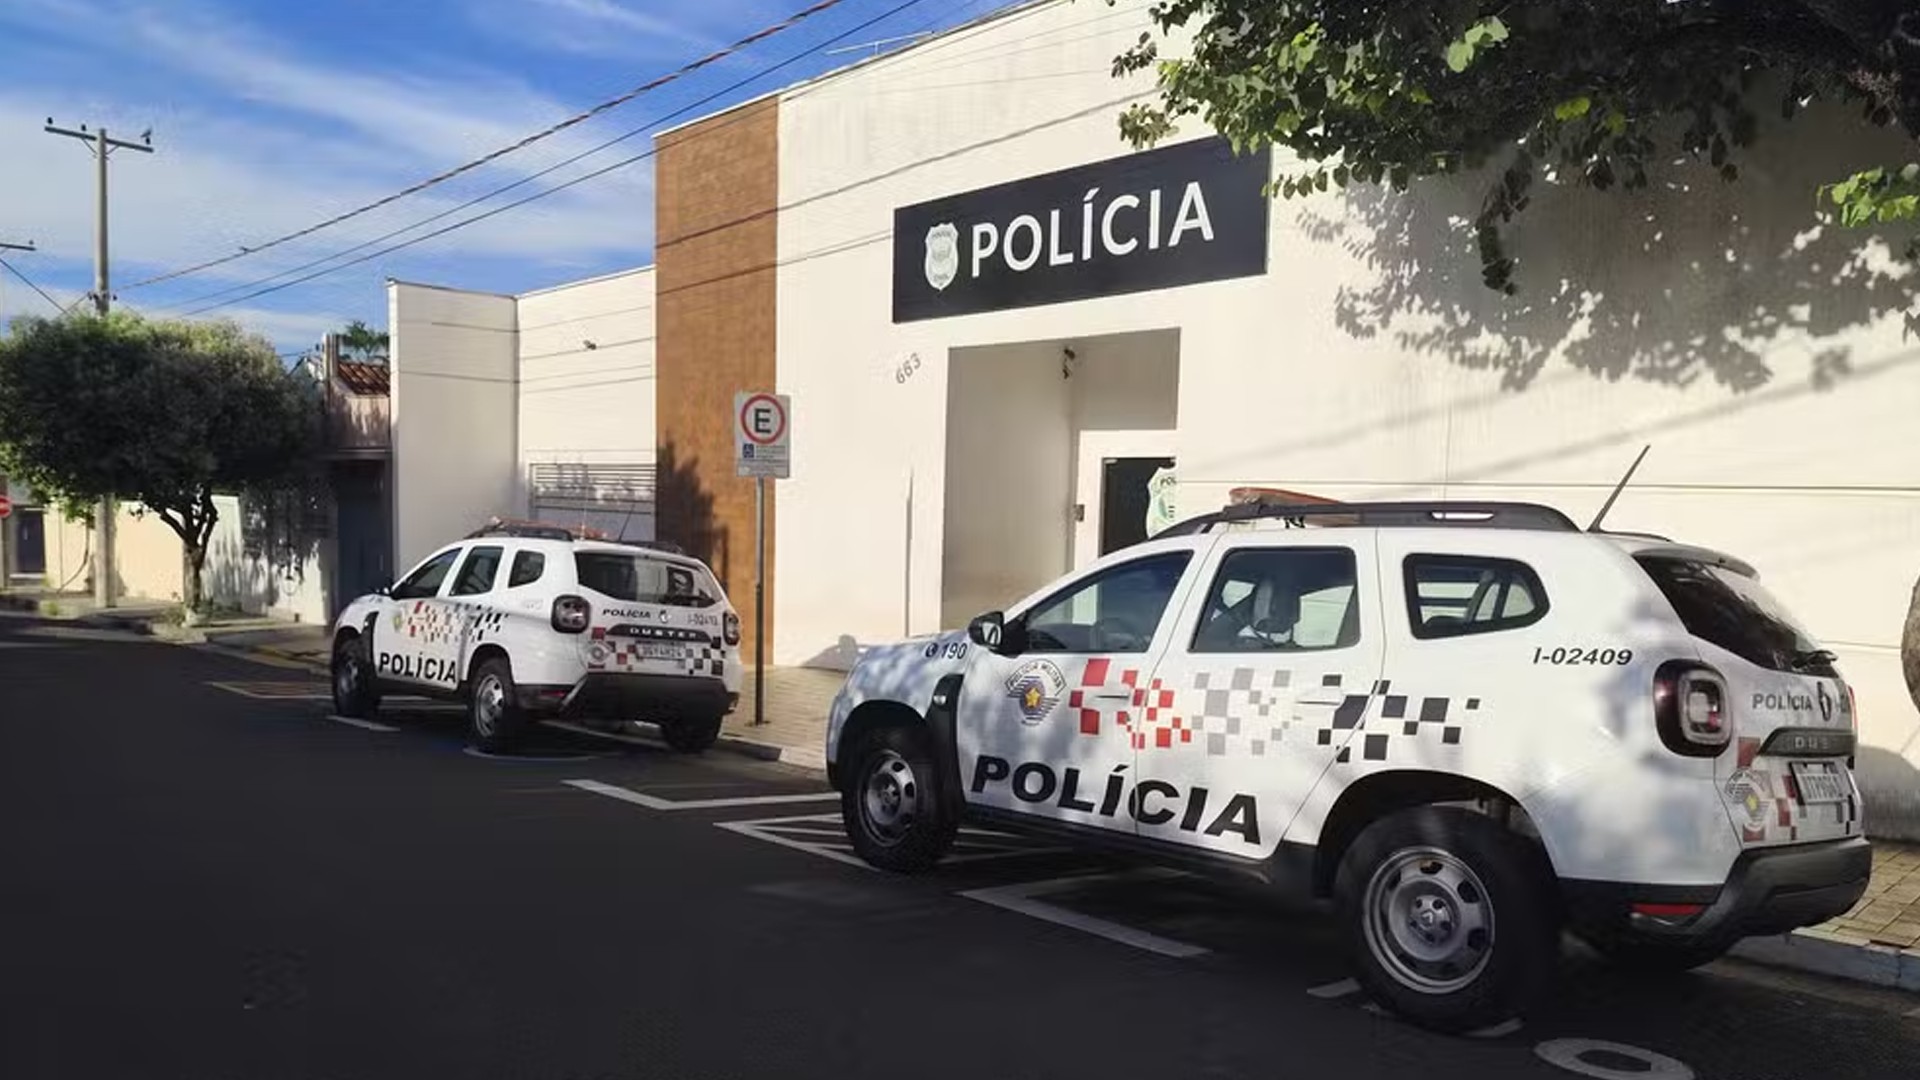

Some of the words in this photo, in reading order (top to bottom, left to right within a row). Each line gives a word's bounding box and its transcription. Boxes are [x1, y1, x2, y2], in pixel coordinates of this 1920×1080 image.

[971, 181, 1215, 278] POLÍCIA
[754, 407, 771, 434] E
[602, 607, 651, 618] POLÍCIA
[630, 627, 697, 638] DUSTER
[941, 641, 968, 660] 190
[1532, 646, 1633, 666] I-02409
[377, 652, 457, 684] POLÍCIA
[1752, 690, 1814, 712] POLÍCIA
[970, 753, 1262, 845] POLÍCIA
